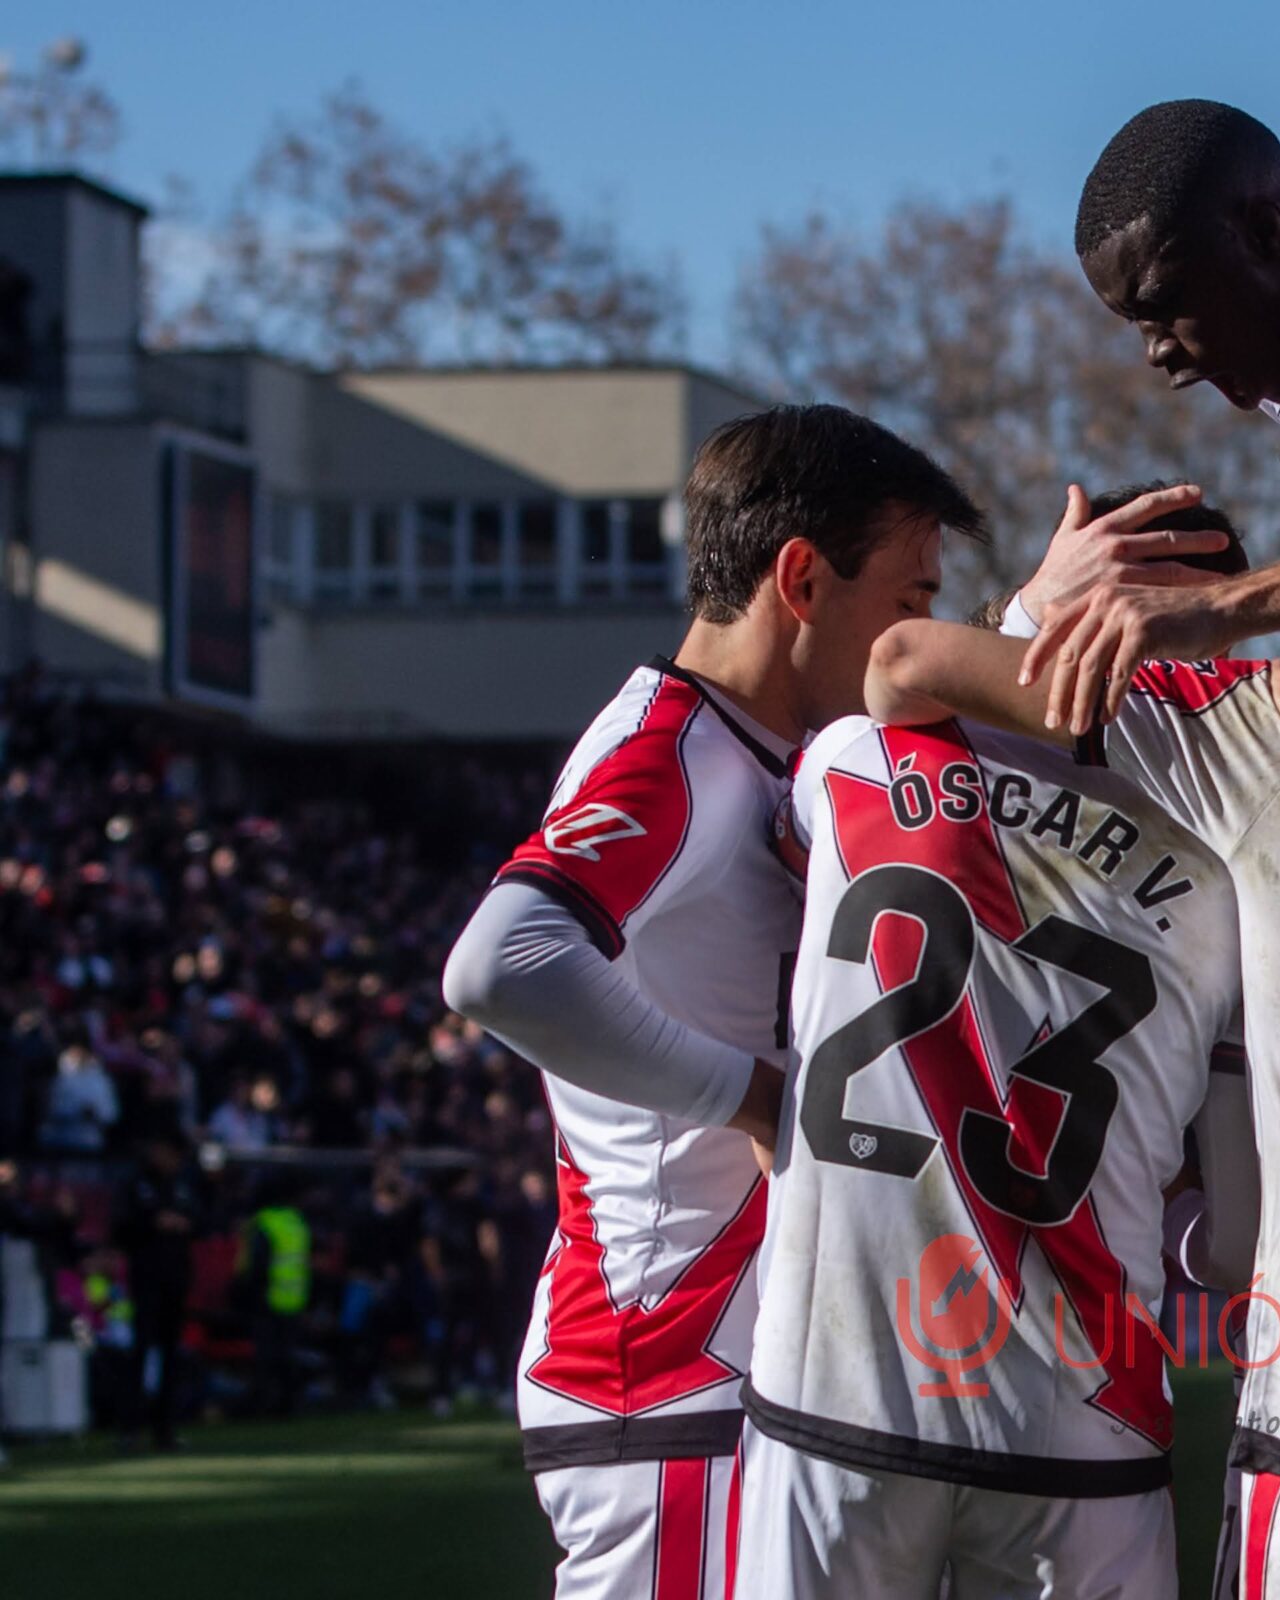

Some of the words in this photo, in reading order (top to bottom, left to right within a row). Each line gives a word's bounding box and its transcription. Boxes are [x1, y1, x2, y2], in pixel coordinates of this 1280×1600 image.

[886, 750, 1140, 877] ÓSCAR
[1132, 852, 1194, 934] V.
[800, 862, 1158, 1226] 23
